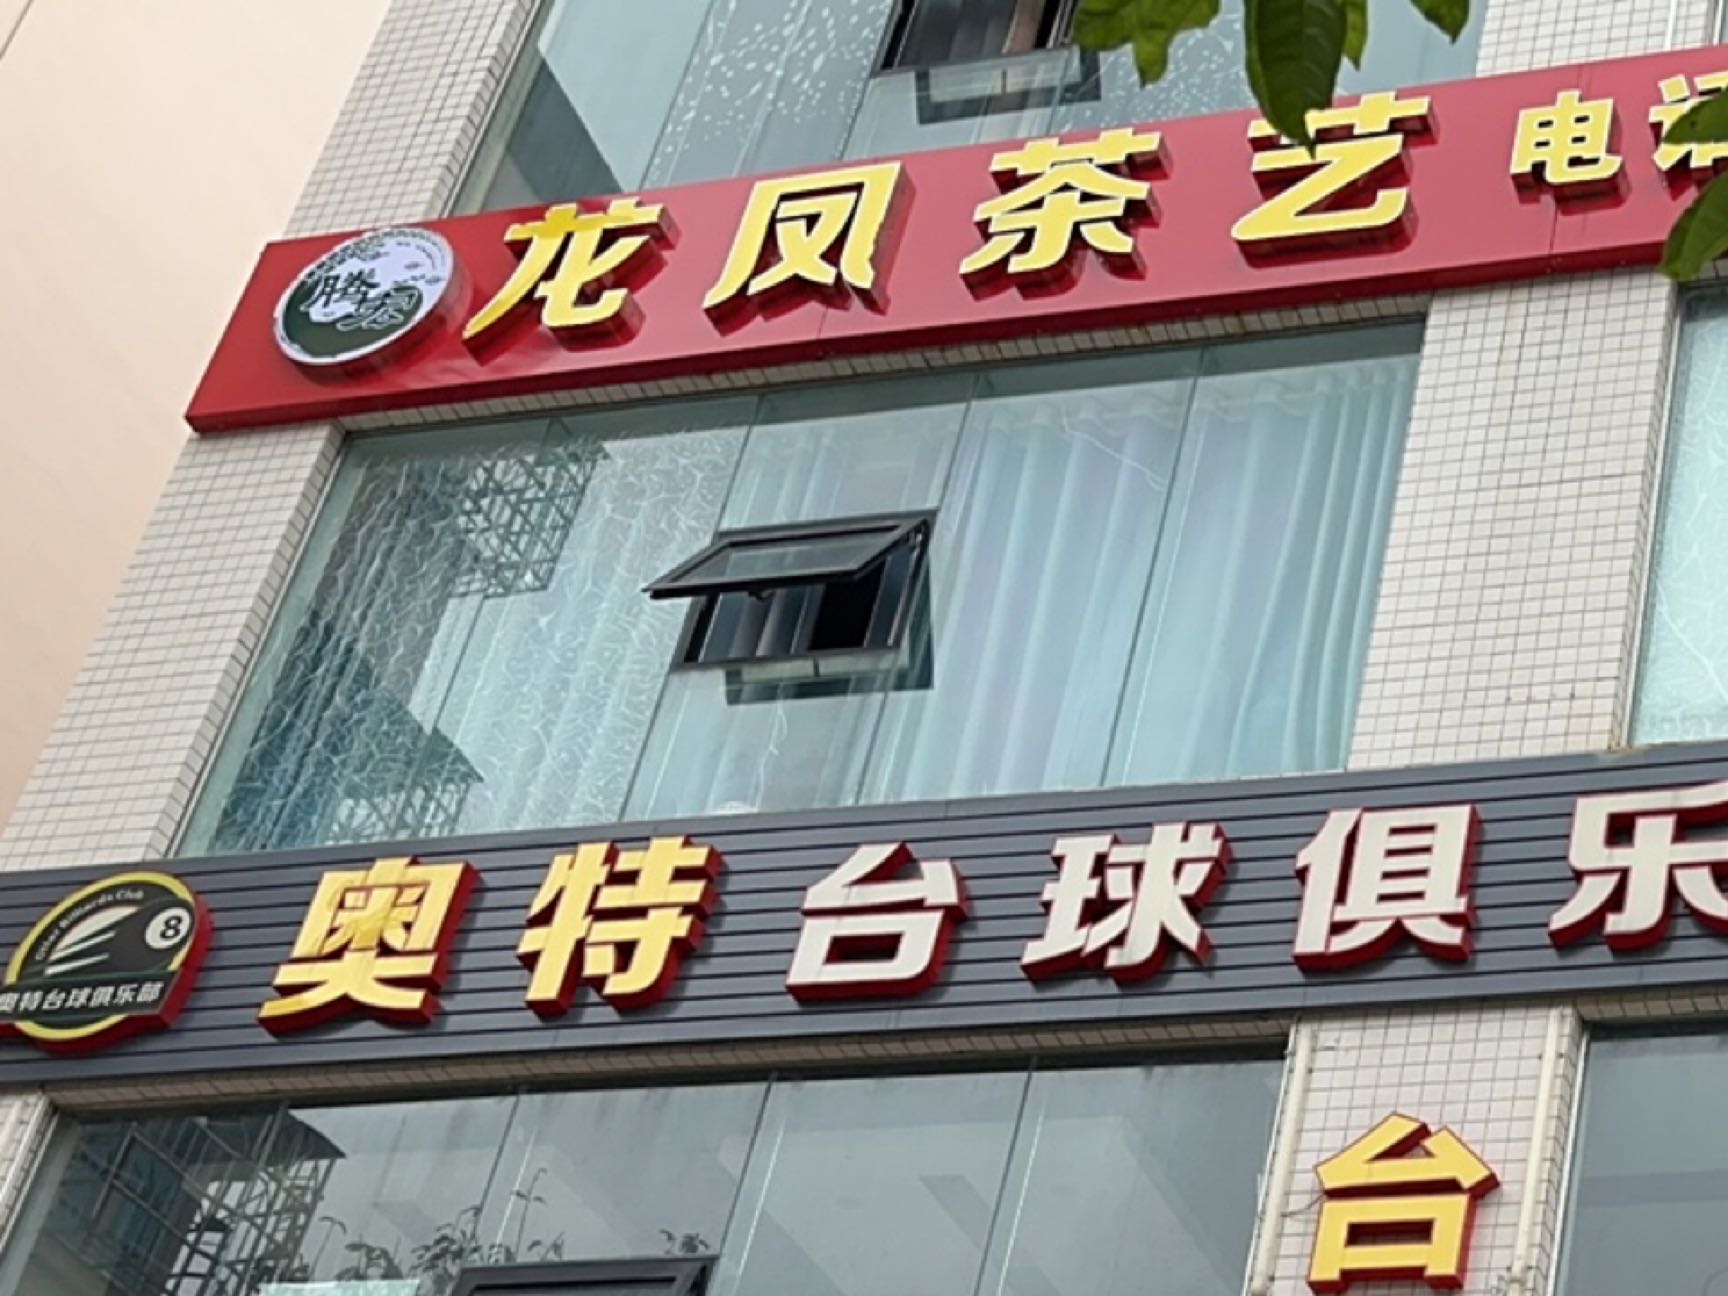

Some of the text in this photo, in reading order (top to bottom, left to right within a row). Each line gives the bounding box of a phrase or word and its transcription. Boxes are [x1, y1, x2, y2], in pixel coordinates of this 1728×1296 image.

[463, 91, 1432, 338] 龙凤茶艺
[159, 915, 182, 941] 8
